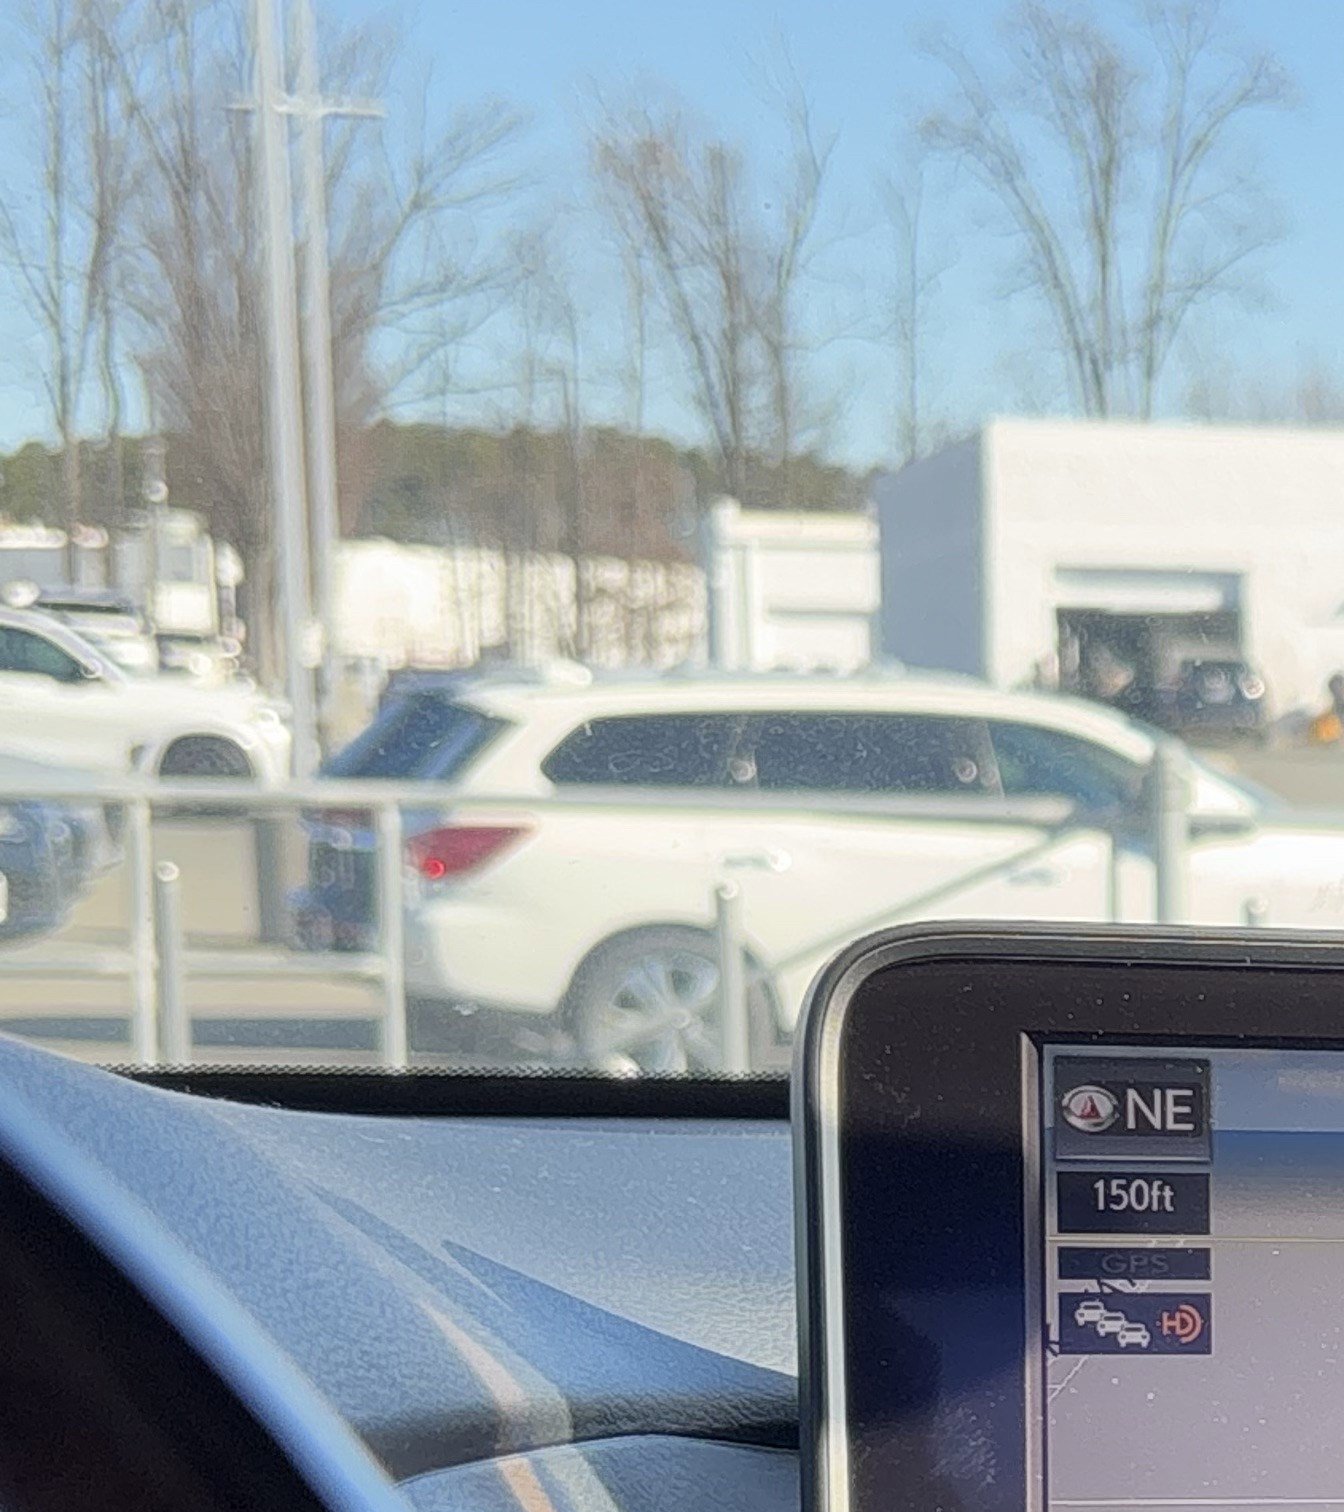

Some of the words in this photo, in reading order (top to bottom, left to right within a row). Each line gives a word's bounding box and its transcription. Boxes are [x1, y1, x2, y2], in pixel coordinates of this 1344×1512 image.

[1126, 1088, 1195, 1131] NE
[1093, 1178, 1175, 1212] 150ft
[1101, 1253, 1170, 1274] GPS
